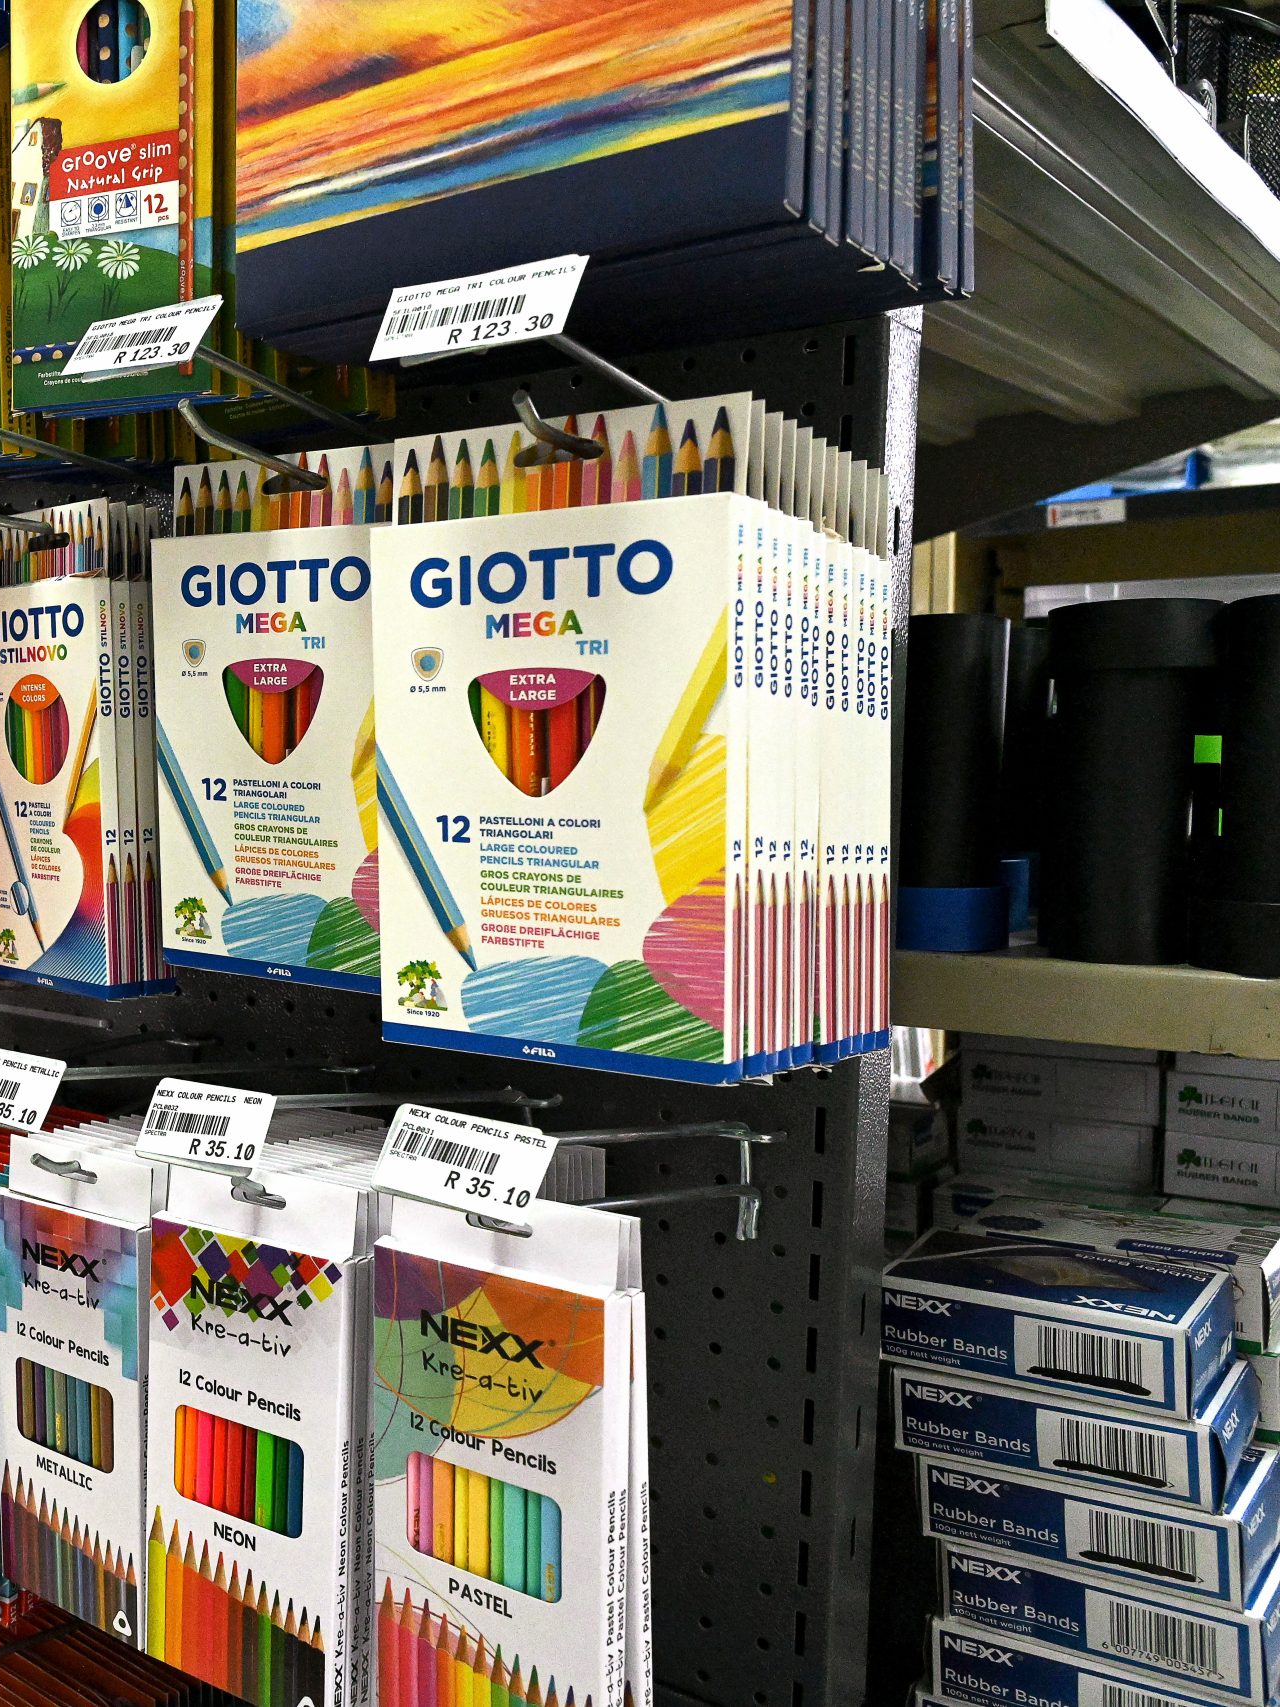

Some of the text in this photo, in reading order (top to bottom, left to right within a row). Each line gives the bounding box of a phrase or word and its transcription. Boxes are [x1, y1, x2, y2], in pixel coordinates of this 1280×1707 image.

[140, 143, 171, 159] slim
[67, 166, 163, 193] Natural Grip
[144, 194, 168, 213] 12
[397, 291, 431, 303] GIOTTO
[437, 286, 460, 295] MEGA
[490, 275, 526, 286] COLOUR
[532, 265, 576, 278] PENCILS
[448, 314, 553, 344] R 123.30
[114, 342, 190, 364] R 123.30
[181, 556, 371, 607] GIOTTO
[410, 539, 673, 608] GIOTTO
[236, 612, 307, 634] MEGA
[486, 610, 583, 639] MEGA
[302, 636, 326, 649] TRI
[576, 640, 608, 655] TRI
[0, 645, 67, 664] STILNOVO
[253, 663, 287, 673] EXTRA
[21, 683, 46, 692] INTENSE
[253, 675, 288, 686] LARGE
[510, 674, 556, 686] EXTRA
[510, 690, 556, 701] LARGE
[202, 778, 227, 801] 12
[14, 801, 27, 817] 12
[436, 814, 470, 843] 12
[480, 816, 543, 826] PASTELLONI
[559, 819, 600, 828] COLORI
[480, 829, 553, 839] TRIANGOLARI
[480, 844, 578, 855] LARGE COLOURED
[480, 856, 599, 869] PENCILS TRIANGULAR
[481, 870, 581, 883] GROS CRAYONS DE
[481, 883, 624, 898] COULEUR TRIANGULAIRES
[481, 896, 596, 912] LÁPICES DE COLORES
[481, 909, 620, 927] GRUESOS TRIANGULARES
[482, 936, 544, 948] FARBSTIFTE
[520, 926, 599, 940] DREIFLÄCHIGE
[1178, 1107, 1259, 1124] RUBBER BANDS
[409, 1108, 547, 1148] NEXX COLOUR PENCILS PASTEL
[189, 1139, 255, 1160] R 35.10
[444, 1170, 531, 1208] R 35.10
[23, 1239, 101, 1282] NEXX
[24, 1271, 101, 1311] Kre-a-tiv
[191, 1274, 293, 1326] NEXX
[885, 1292, 952, 1317] NEXX
[17, 1322, 110, 1366] 12 Colour Pencils
[191, 1312, 291, 1357] Kre-a-tiv
[421, 1309, 544, 1369] NEXX
[885, 1325, 1008, 1361] Rubber Bands
[423, 1351, 543, 1403] Kre-a-tiv
[179, 1369, 301, 1421] 12 Colour Pencils
[905, 1384, 973, 1409] NEXX
[410, 1411, 557, 1475] 12 Colour Pencils
[907, 1417, 1031, 1453] Rubber Bands
[36, 1455, 93, 1491] METALLIC
[214, 1522, 256, 1551] NEON
[448, 1578, 512, 1618] PASTEL
